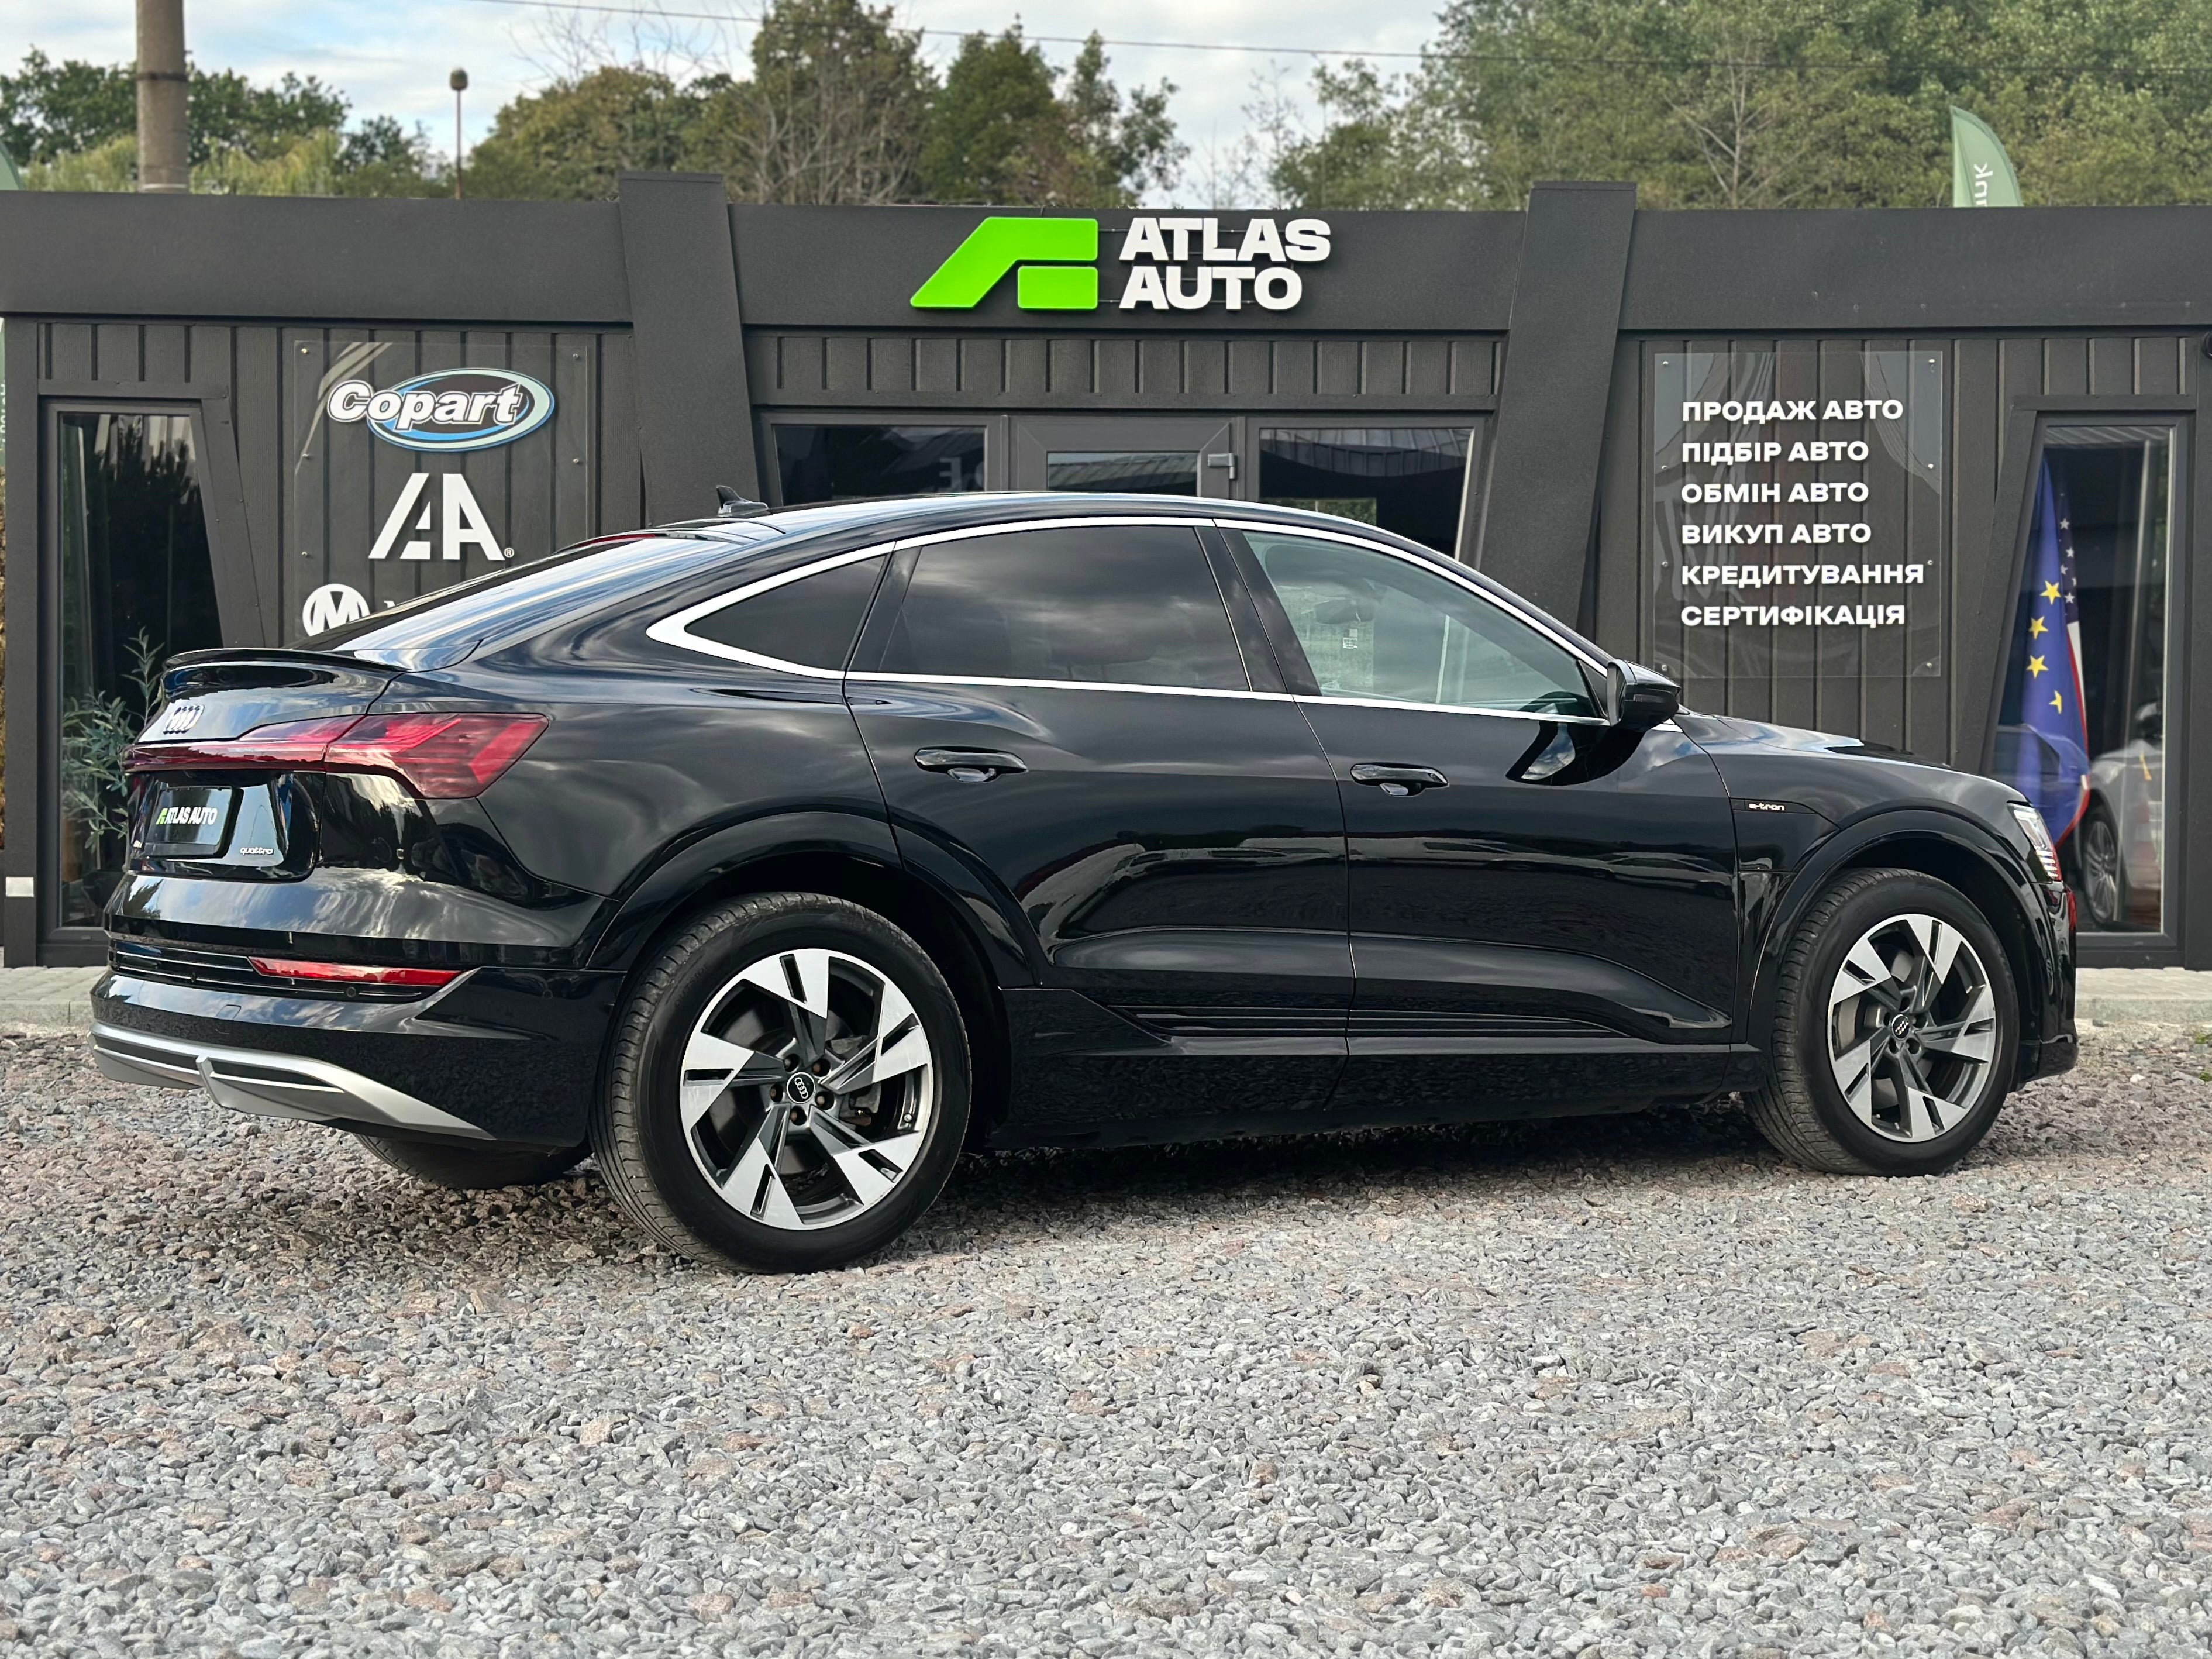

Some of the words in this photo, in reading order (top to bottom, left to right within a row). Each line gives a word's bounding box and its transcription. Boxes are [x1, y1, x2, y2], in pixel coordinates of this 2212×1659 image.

[1119, 217, 1331, 262] ATLAS
[1119, 266, 1303, 310] AUTO
[328, 380, 523, 431] Copart
[1683, 400, 1816, 424] ПРОДАЖ
[1822, 399, 1904, 420] АВТО
[1682, 442, 1782, 466] ПІДБІР
[1788, 440, 1869, 462] АВТО
[1681, 483, 1780, 504] ОБМІН
[1788, 481, 1869, 503] АВТО
[1682, 524, 1783, 545] ВИКУП
[1790, 522, 1872, 543] АВТО
[1682, 563, 1924, 588] КРЕДИТУВАННЯ
[1681, 605, 1905, 629] СЕРТИФІКАЦІЯ
[164, 807, 191, 825] ATLAS
[188, 807, 218, 825] AUTO
[1749, 803, 1784, 811] e-tron
[240, 847, 274, 855] quattro
